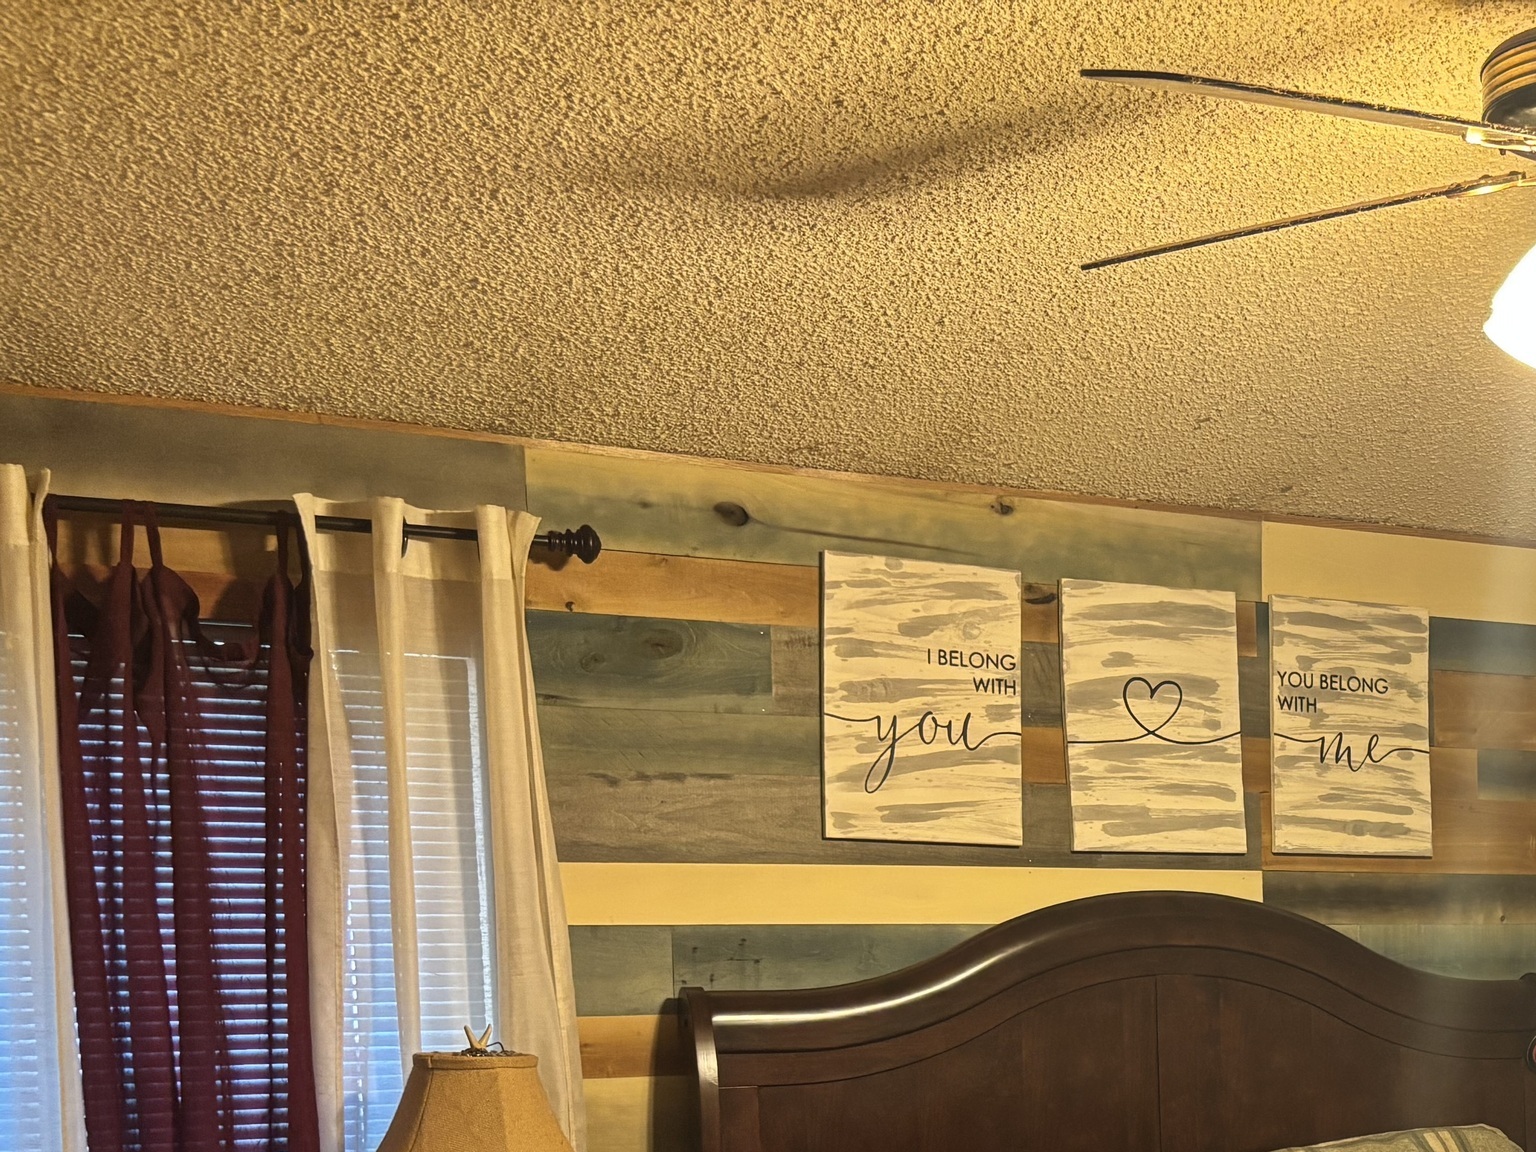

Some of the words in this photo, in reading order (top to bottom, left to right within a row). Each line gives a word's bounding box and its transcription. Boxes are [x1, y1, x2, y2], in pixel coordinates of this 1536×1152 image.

[938, 649, 1016, 671] BELONG
[973, 677, 1016, 696] WITH
[1277, 670, 1314, 689] YOU
[1319, 673, 1389, 695] BELONG
[1277, 695, 1317, 714] WITH
[862, 711, 988, 794] you
[1312, 731, 1392, 773] me
